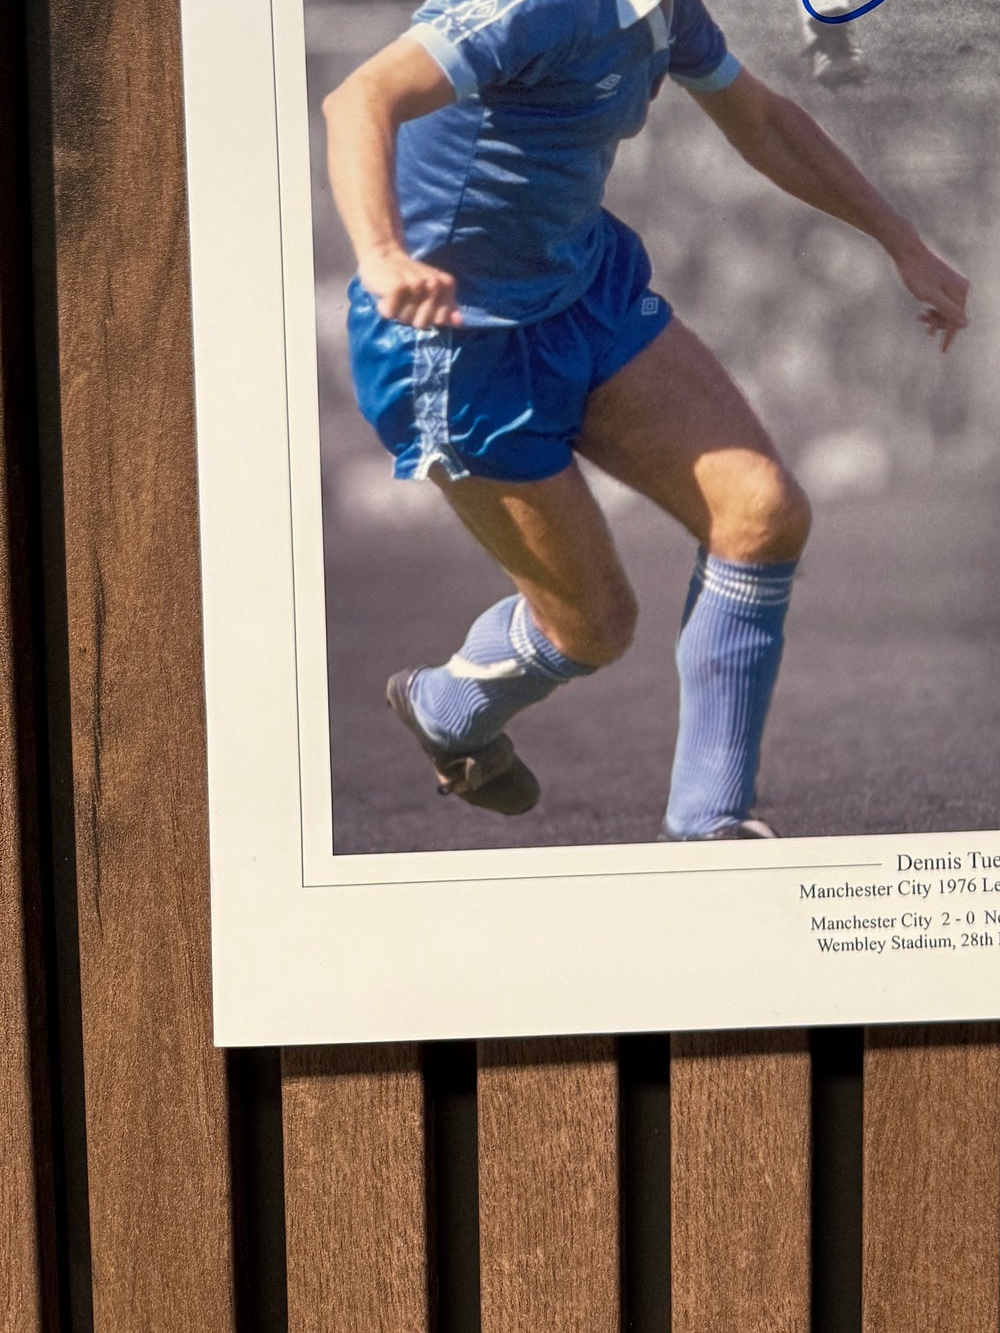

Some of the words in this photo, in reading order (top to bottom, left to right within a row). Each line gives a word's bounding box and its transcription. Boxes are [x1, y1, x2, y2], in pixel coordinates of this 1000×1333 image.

[896, 852, 962, 872] Dennis
[799, 882, 894, 899] Manchester
[897, 880, 932, 899] City
[939, 877, 977, 894] 1976
[811, 914, 897, 931] Manchester
[901, 912, 933, 931] City
[941, 911, 951, 926] 2
[965, 911, 975, 925] 0
[817, 936, 886, 955] Wembley
[891, 934, 957, 951] Stadium,
[960, 931, 994, 947] 28th
